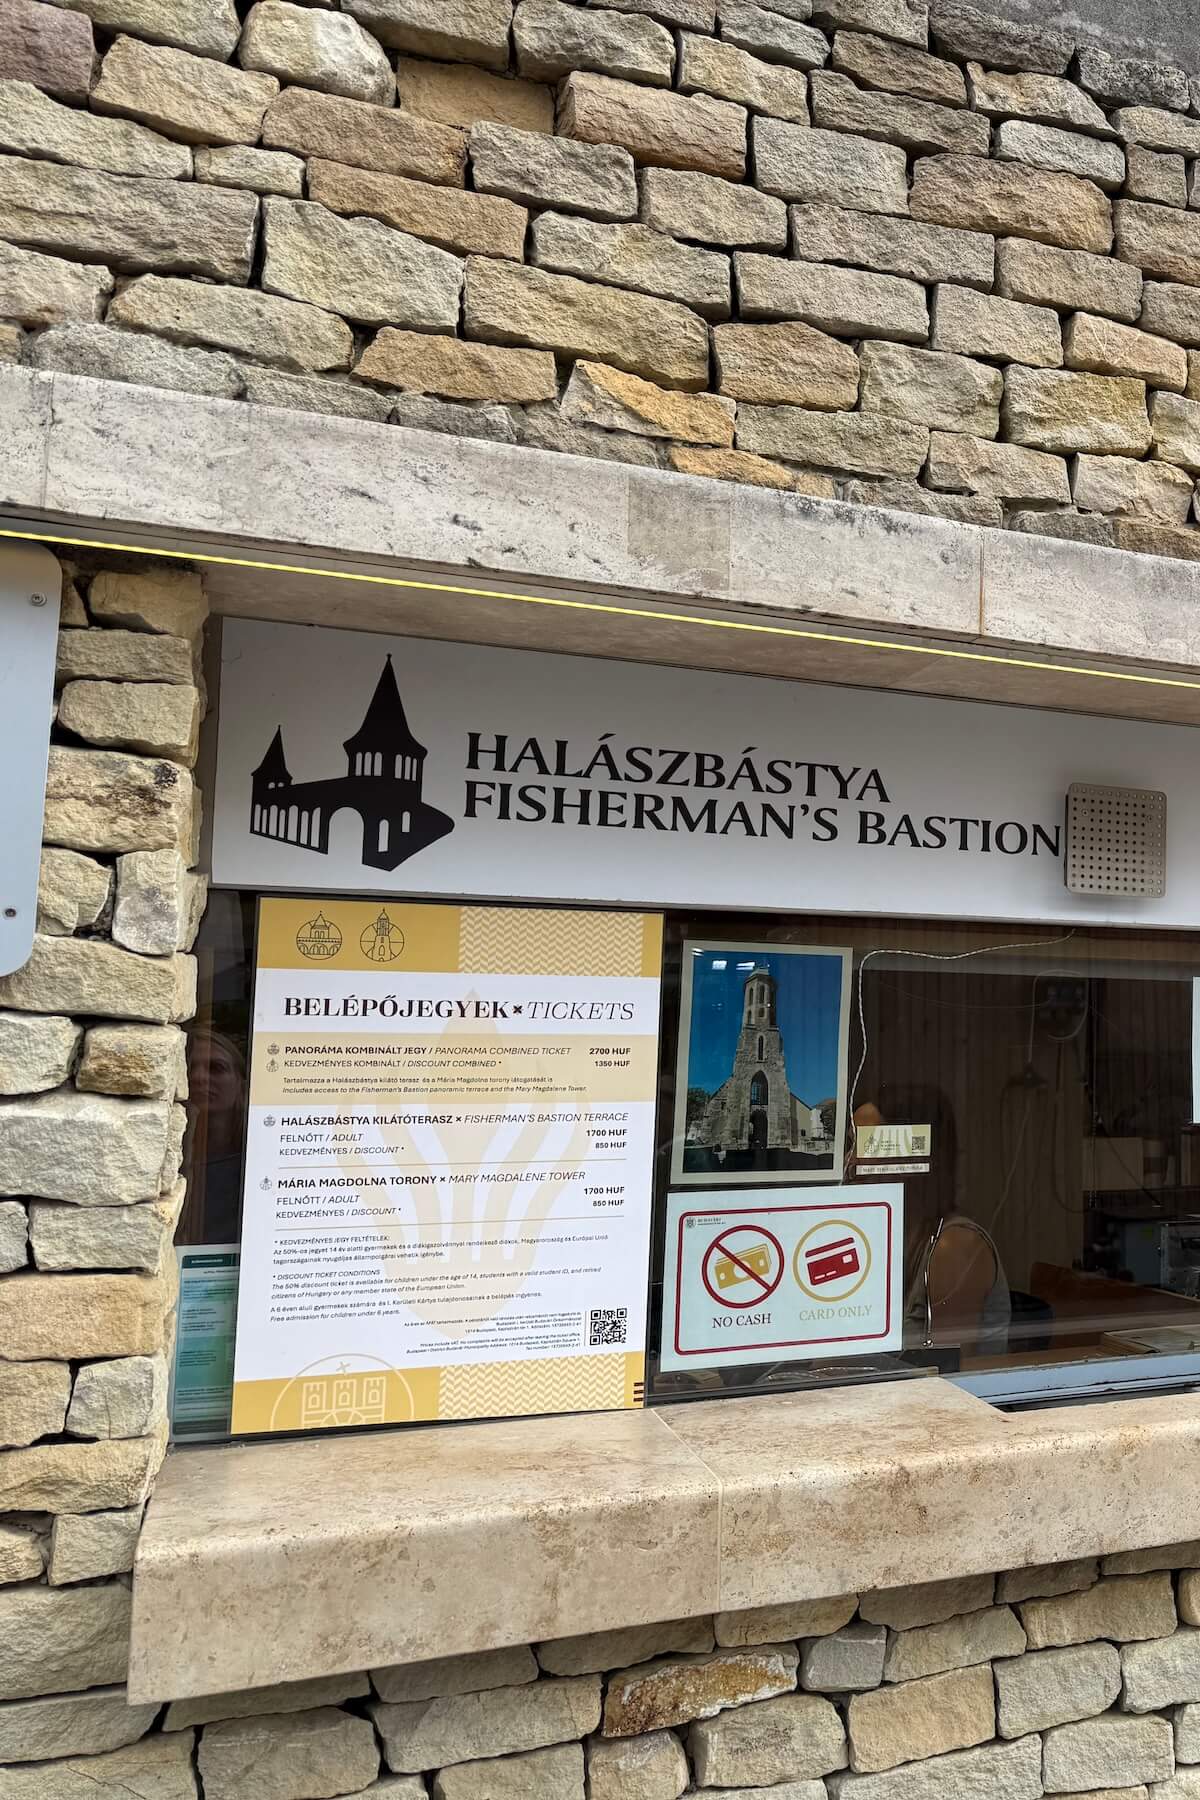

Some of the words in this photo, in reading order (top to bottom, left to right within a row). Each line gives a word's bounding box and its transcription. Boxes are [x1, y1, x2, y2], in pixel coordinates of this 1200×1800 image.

[465, 731, 891, 804] HALÁSZBÁSTYA
[464, 780, 839, 842] FISHERMAN'S
[858, 811, 1061, 859] BASTION
[283, 995, 509, 1018] BELÉPŐJEGYEK
[527, 1001, 634, 1020] TICKETS
[284, 1045, 342, 1054] PANORÁMA
[344, 1045, 401, 1054] KOMBINÁLT
[403, 1046, 427, 1054] JEGY
[434, 1047, 486, 1055] PANORAMA
[489, 1047, 539, 1055] COMBINED
[541, 1047, 572, 1055] TICKET
[589, 1047, 610, 1055] 2700
[611, 1047, 630, 1055] HUF
[284, 1059, 352, 1067] KEDVEZMÉNYES
[353, 1059, 401, 1067] KOMBINÁLT
[281, 1114, 370, 1126] HALÁSZBÁSTYA
[372, 1113, 453, 1125] KILÁTÓTERASZ
[464, 1113, 535, 1124] FISHERMAN'S
[537, 1113, 581, 1122] BASTION
[584, 1112, 628, 1122] TERRACE
[279, 1132, 324, 1143] FELNŐTT
[330, 1133, 364, 1142] ADULT
[608, 1128, 627, 1136] HUF
[279, 1146, 348, 1156] KEDVEZMÉNYES
[354, 1146, 400, 1154] DISCOUNT
[277, 1177, 316, 1188] MÁRIA
[319, 1177, 387, 1187] MAGDOLNA
[389, 1175, 437, 1185] TORONY
[448, 1174, 479, 1184] MARY
[480, 1172, 546, 1182] MAGDALENE
[549, 1171, 585, 1181] TOWER
[276, 1194, 321, 1205] FELNŐTT
[327, 1194, 361, 1204] ADULT
[583, 1187, 604, 1195] 1700
[605, 1186, 624, 1194] HUF
[275, 1208, 344, 1219] KEDVEZMÉNYES
[351, 1207, 397, 1216] DISCOUNT
[277, 1272, 314, 1280] DISCOUNT
[337, 1269, 381, 1277] CONDITIONS
[712, 1317, 733, 1328] NO
[736, 1313, 772, 1326] CASH
[799, 1309, 835, 1321] CARD
[838, 1305, 873, 1318] ONLY
